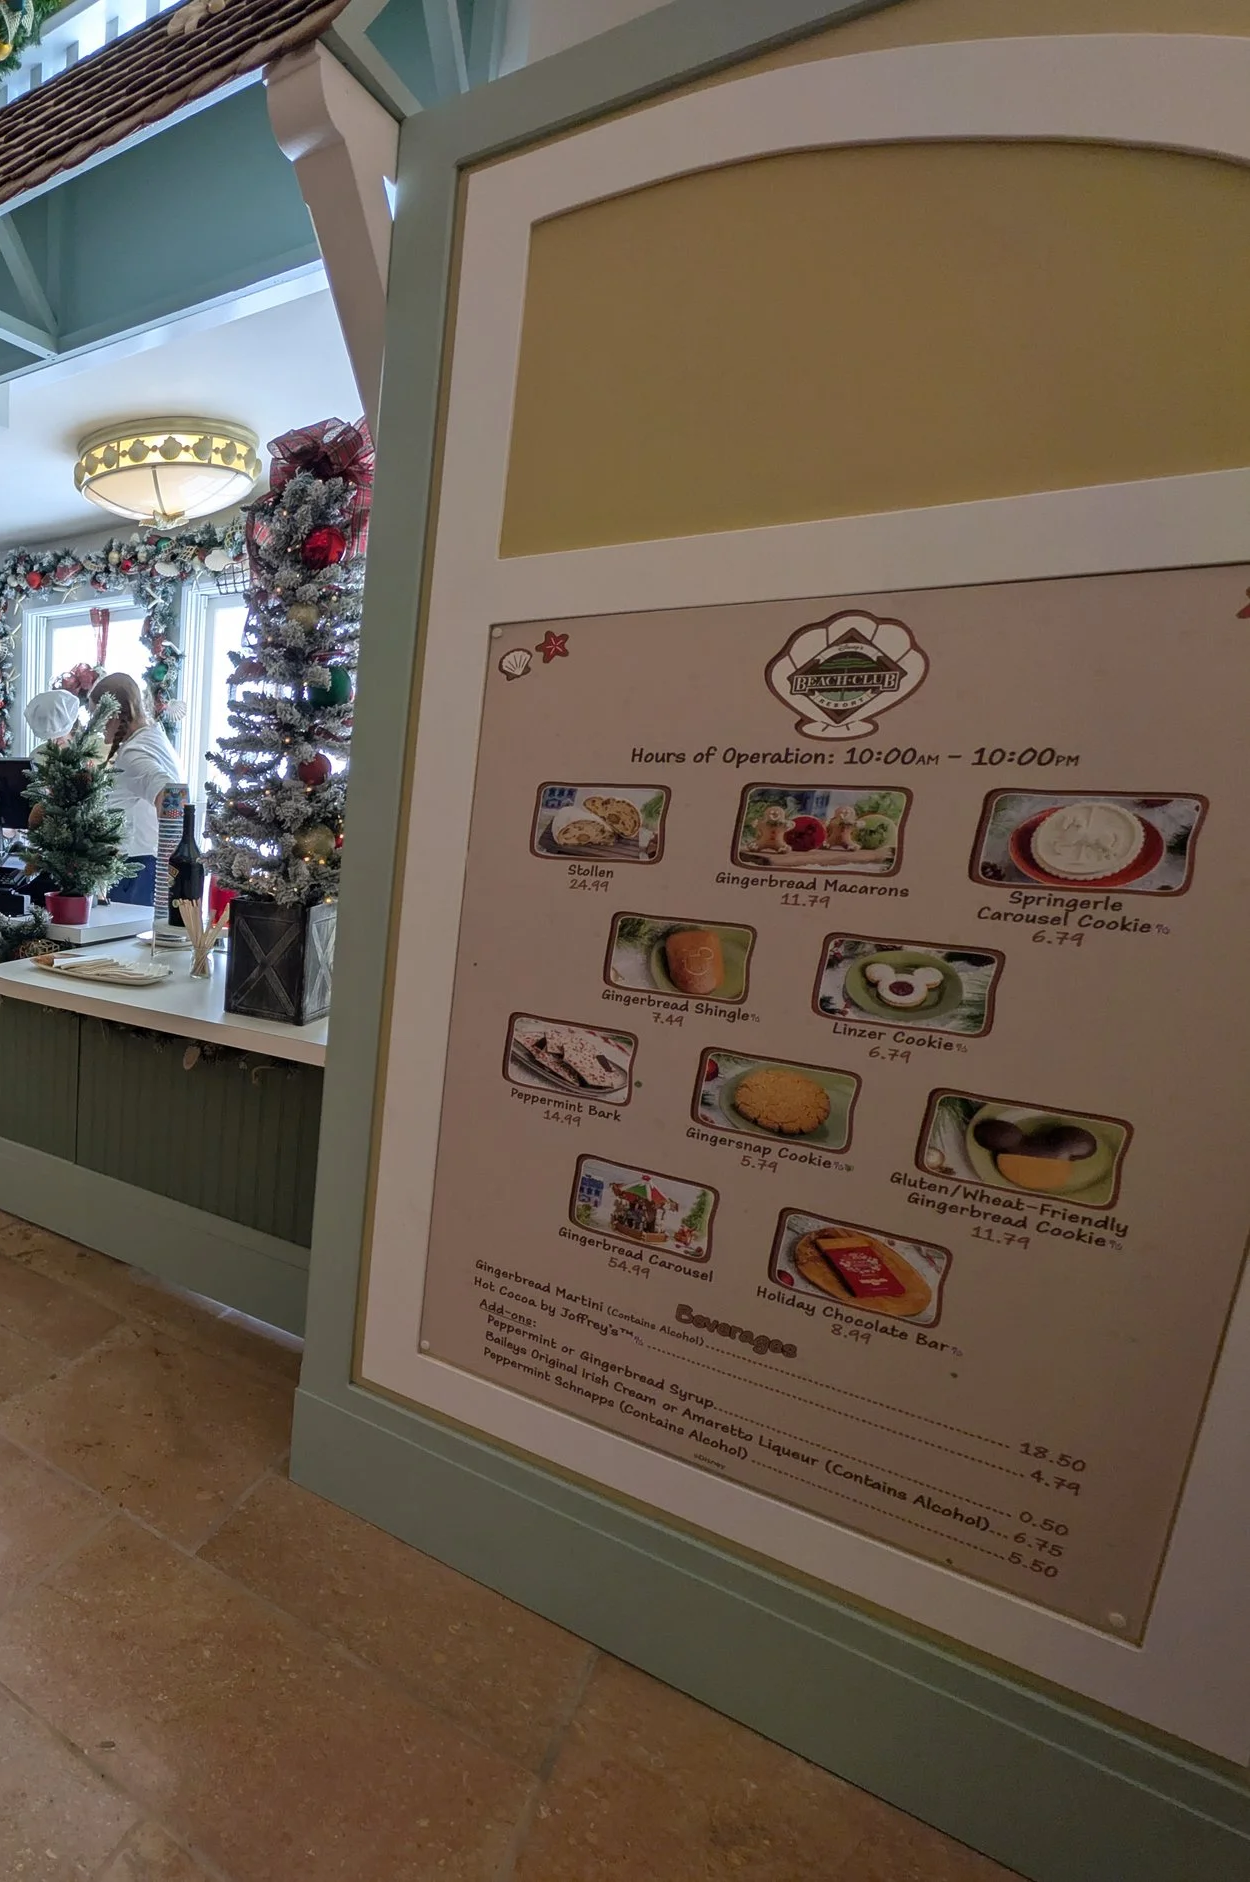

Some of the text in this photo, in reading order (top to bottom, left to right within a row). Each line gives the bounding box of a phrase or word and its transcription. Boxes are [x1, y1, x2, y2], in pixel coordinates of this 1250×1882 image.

[819, 697, 864, 708] RESORT
[630, 747, 686, 764] Hours
[693, 747, 716, 764] of
[722, 747, 835, 768] Operation:
[843, 747, 940, 766] 10:00AM
[971, 747, 1080, 767] 10:00PM
[567, 864, 614, 879] Stollen
[568, 878, 609, 892] 24.99
[715, 872, 910, 898] Gingerbread Macarons
[780, 893, 831, 909] 11.79
[1009, 891, 1123, 913] Springerle
[977, 906, 1151, 934] Carousel Cookie
[1032, 930, 1085, 947] 6.79
[602, 989, 750, 1023] Gingerbread Shingle
[652, 1012, 685, 1027] 7.49
[832, 1022, 954, 1051] Linzer Cookie
[869, 1046, 912, 1064] 6.79
[510, 1087, 622, 1122] Peppermint Bark
[543, 1110, 581, 1127] 14.99
[686, 1126, 832, 1169] Gingersnap Cookie
[740, 1155, 779, 1174] 5.79
[890, 1171, 1129, 1239] Gluten/Wheat-Friendly
[907, 1192, 1106, 1248] Gingerbread Cookie
[971, 1226, 1032, 1251] 11.79
[558, 1226, 714, 1283] Gingerbread Carousel
[608, 1257, 651, 1280] 54.99
[479, 1298, 537, 1328] Add-ons:
[756, 1286, 949, 1352] Holiday Chocolate Bar
[675, 1303, 798, 1359] Beverages
[831, 1323, 872, 1345] 8.99
[475, 1259, 1087, 1472] Gingerbread Martini (Contains Alcohol) 18.50
[473, 1276, 495, 1292] Hot
[499, 1286, 537, 1307] Cocoa
[541, 1302, 556, 1318] by
[1030, 1469, 1081, 1497] 4.79
[487, 1314, 1070, 1537] Peppermint or Gingerbread Syrup 0.50
[485, 1331, 1064, 1559] Baileys Original Irish Cream or Amaretto Liqueur (Contains Alcohol) 6.75
[483, 1346, 1059, 1578] Peppermint Schnapps (Contains Alcohol) 5.50
